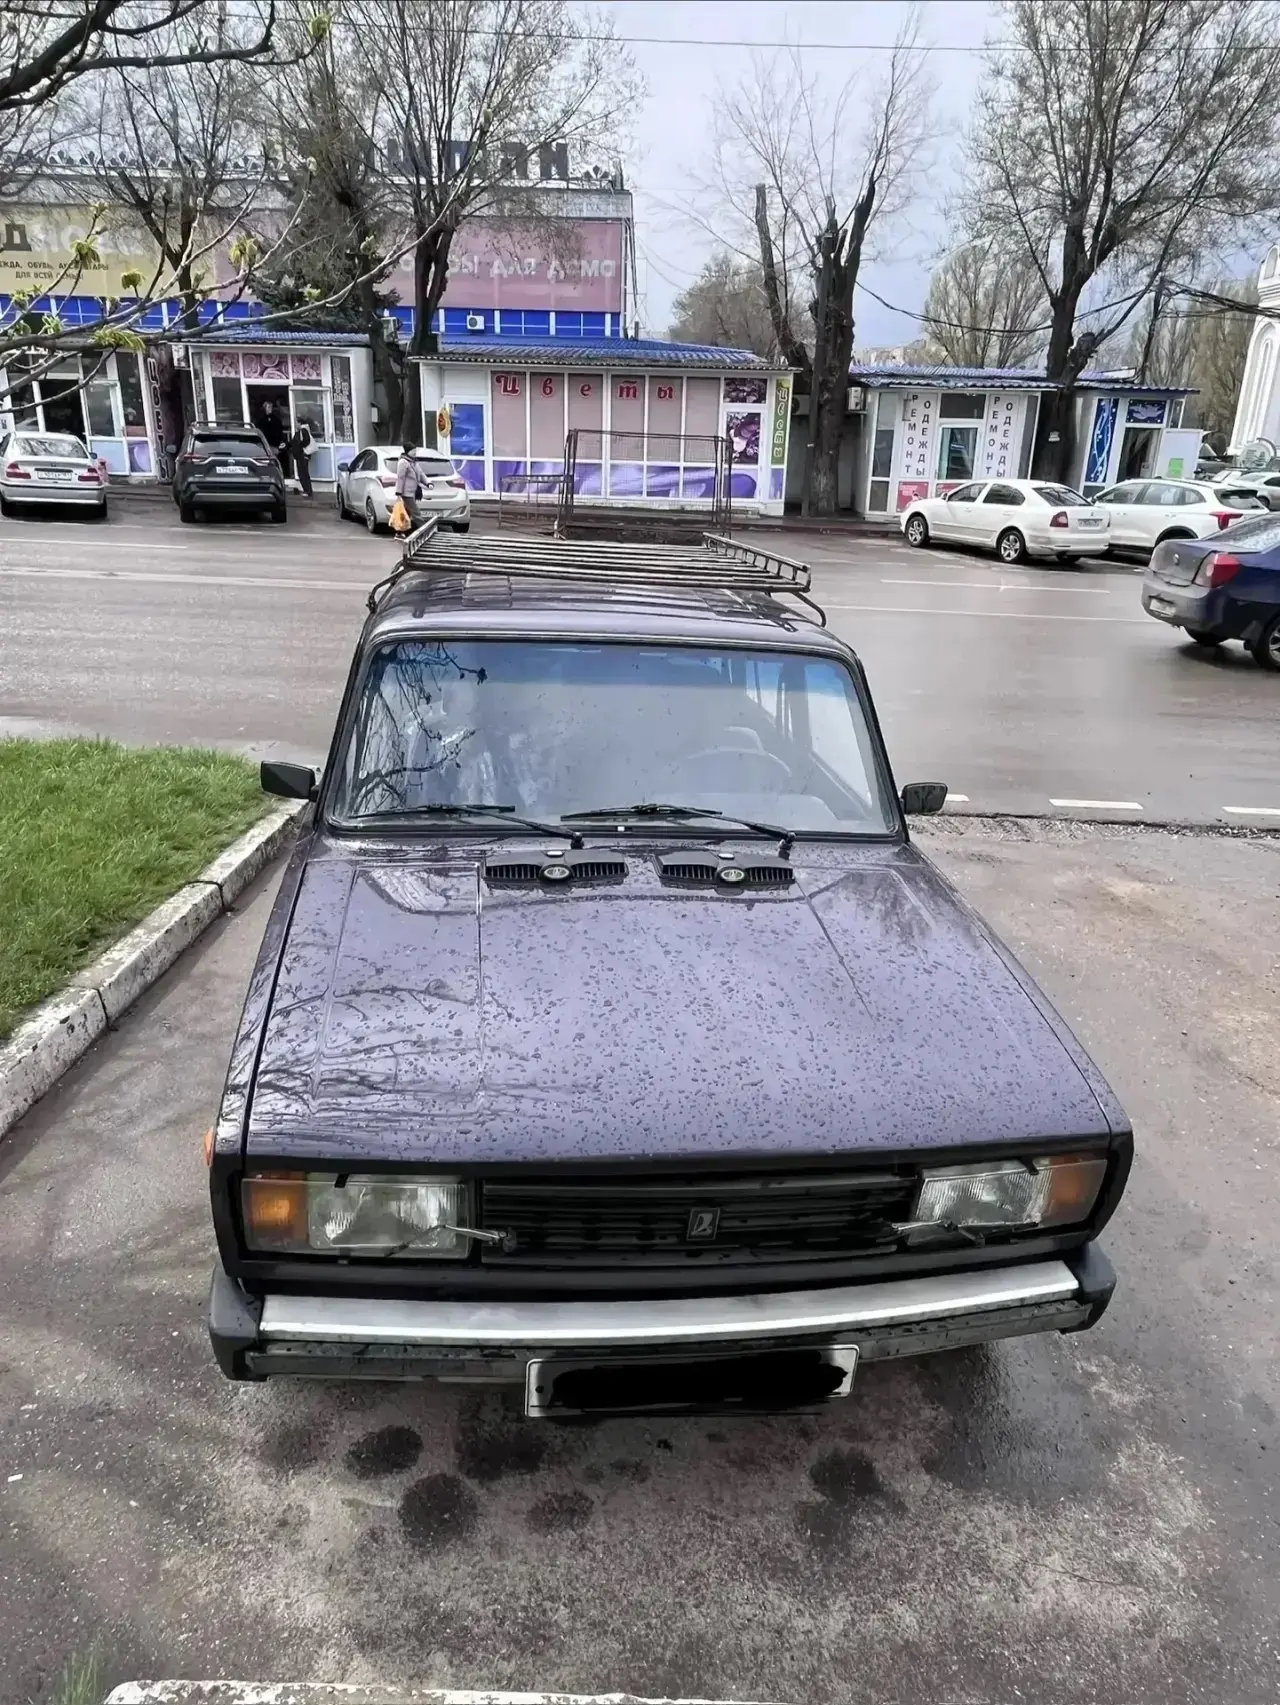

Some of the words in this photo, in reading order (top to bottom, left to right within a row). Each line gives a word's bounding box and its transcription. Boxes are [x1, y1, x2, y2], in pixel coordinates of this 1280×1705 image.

[905, 394, 919, 474] РЕМОНТ
[915, 400, 932, 476] ОДЕЖДЫ
[985, 396, 1001, 475] РЕМОНТ
[996, 402, 1014, 478] ОДЕЖДЫ
